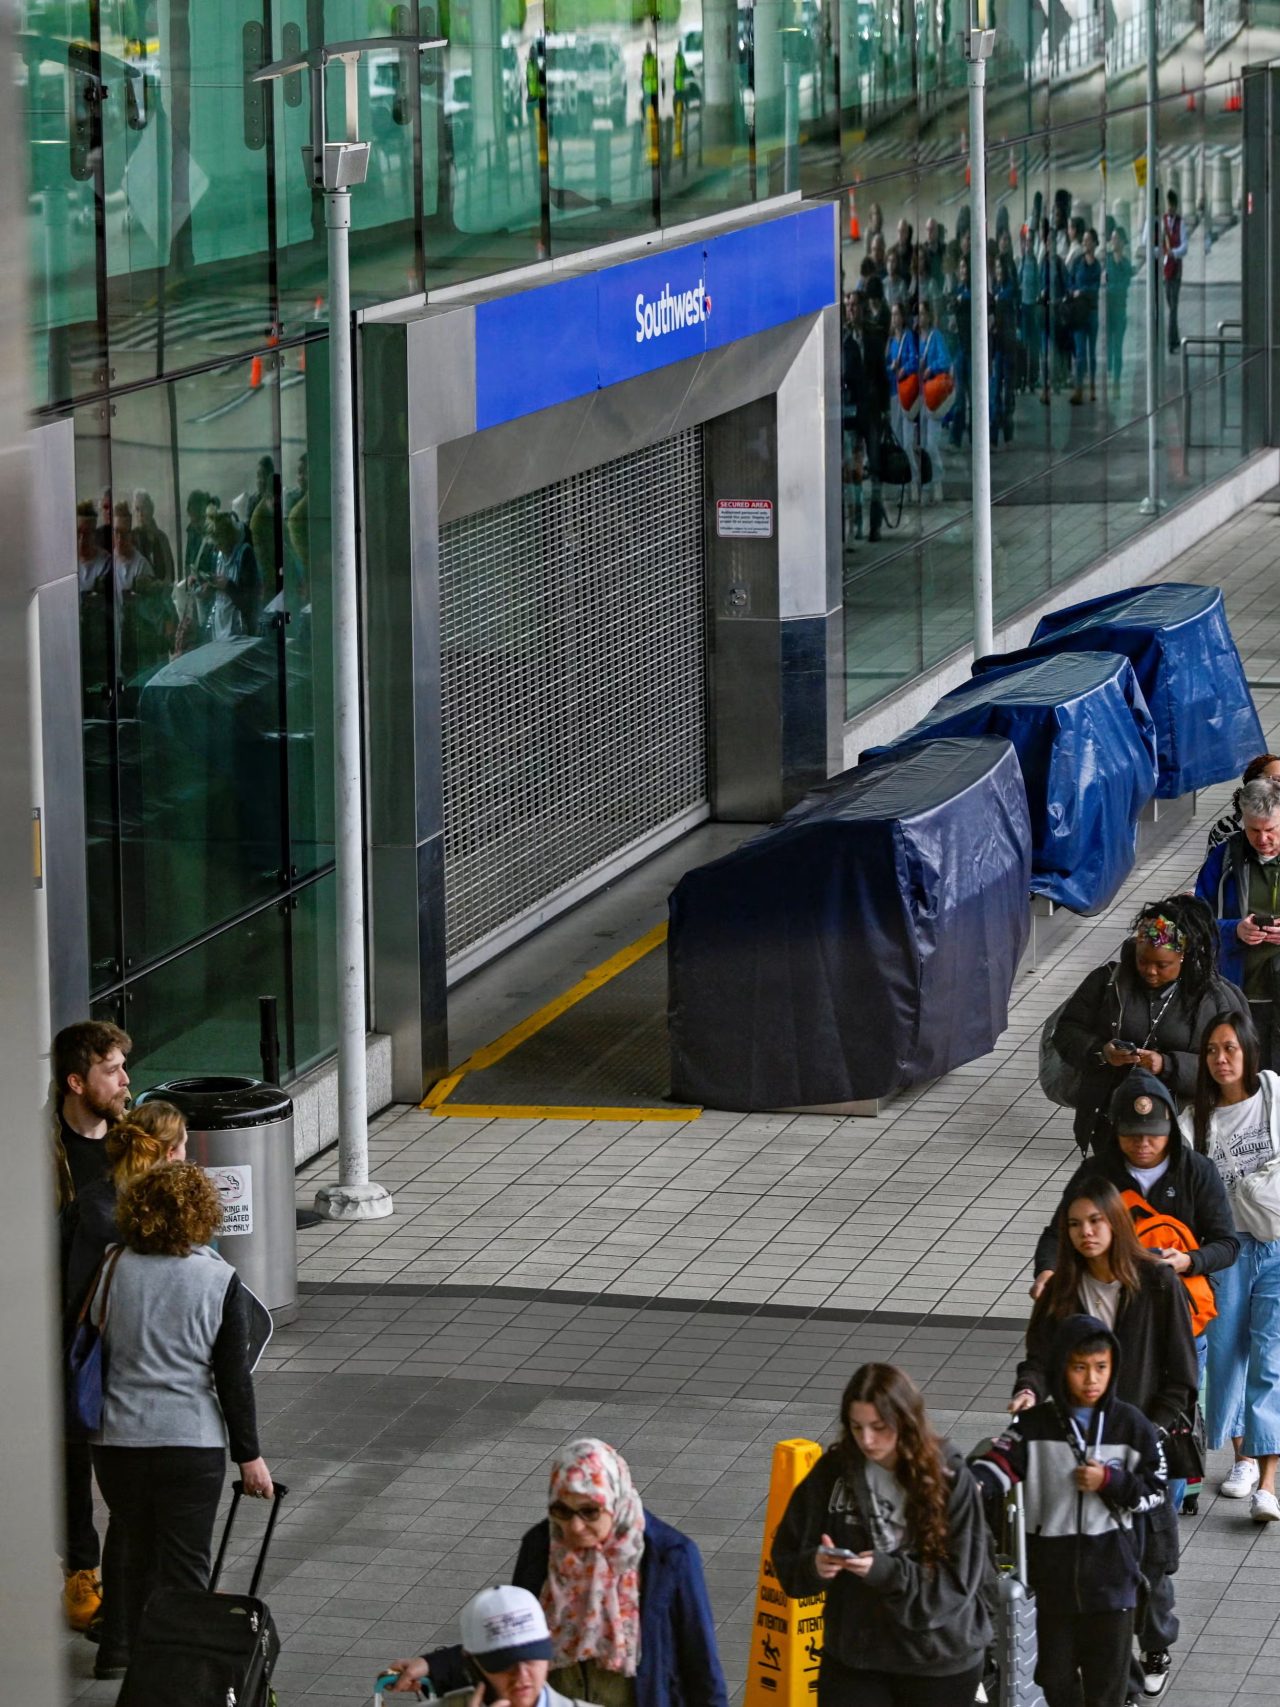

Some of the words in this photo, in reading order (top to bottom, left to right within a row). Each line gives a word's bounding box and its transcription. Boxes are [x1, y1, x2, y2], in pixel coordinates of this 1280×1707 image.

[635, 279, 706, 343] Southwest
[224, 1205, 240, 1213] KING
[241, 1204, 248, 1212] IN
[223, 1214, 250, 1223] GNATED
[233, 1223, 250, 1232] ONLY
[757, 1612, 788, 1634] ATTENTION
[797, 1616, 824, 1635] ATTENT
